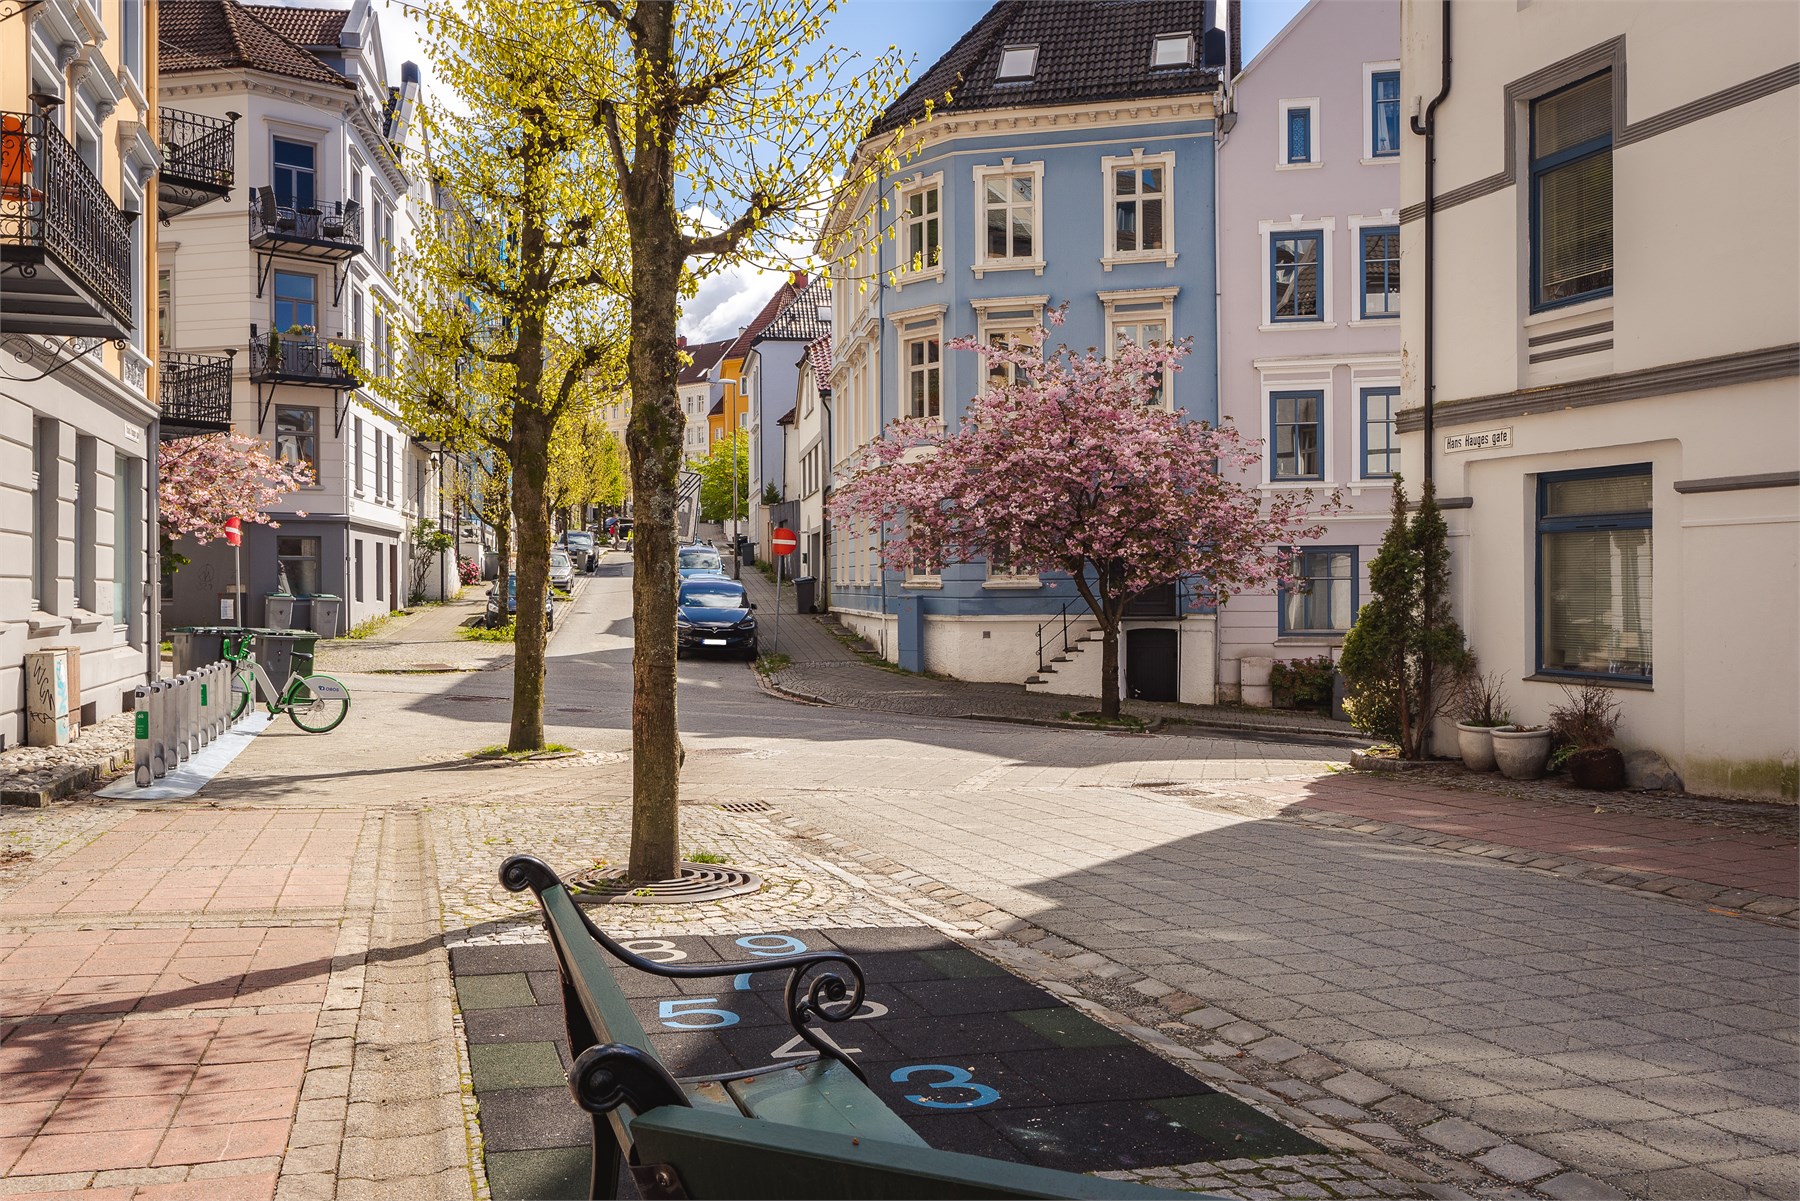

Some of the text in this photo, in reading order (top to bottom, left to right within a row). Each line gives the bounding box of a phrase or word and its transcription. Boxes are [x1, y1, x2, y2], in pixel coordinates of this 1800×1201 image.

[1447, 431, 1508, 449] Hans Hauges gate
[618, 934, 808, 963] 8 9
[658, 998, 741, 1029] 5
[890, 1064, 1000, 1109] 3
